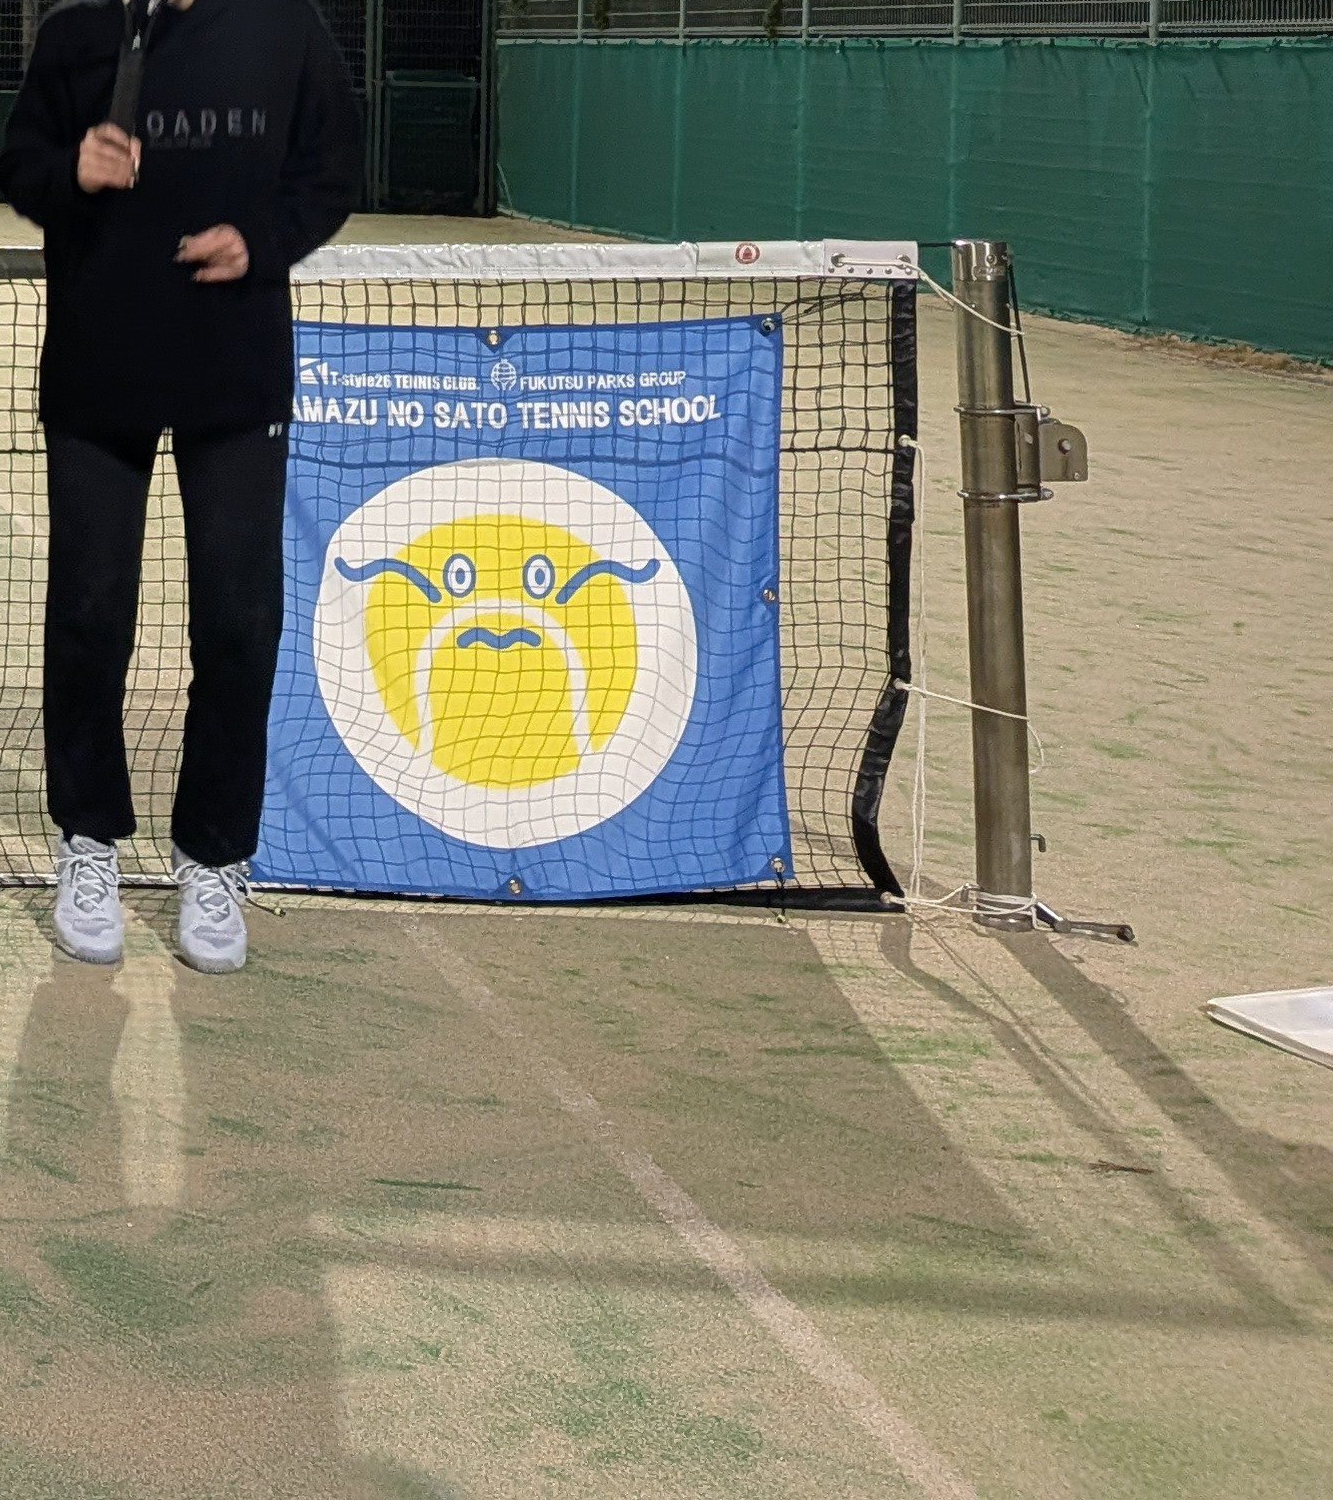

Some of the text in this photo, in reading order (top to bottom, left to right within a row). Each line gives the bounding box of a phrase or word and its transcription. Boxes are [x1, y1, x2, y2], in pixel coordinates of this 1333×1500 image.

[146, 108, 266, 137] OADEN
[395, 374, 440, 390] TENNIS
[520, 370, 686, 392] FUKUTSU PARKS GROUP
[292, 394, 721, 430] AMAZU NO SATO TENNIS SCHOOL
